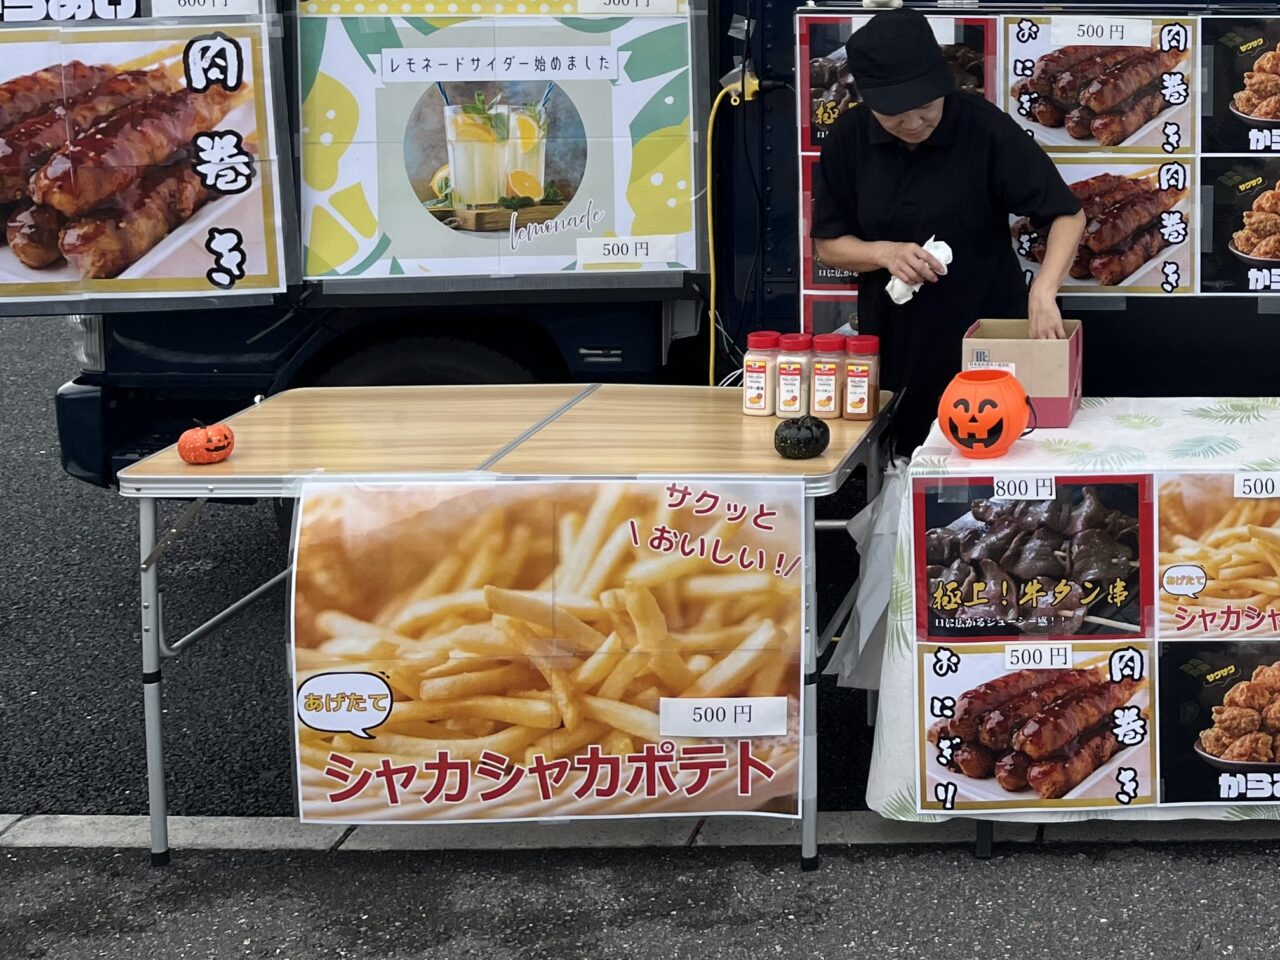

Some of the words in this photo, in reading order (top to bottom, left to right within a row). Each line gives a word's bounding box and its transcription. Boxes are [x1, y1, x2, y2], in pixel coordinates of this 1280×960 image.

[389, 54, 611, 74] レモネードサイダー始めました
[508, 200, 607, 251] lemonade
[664, 482, 777, 531] サクッと
[1165, 573, 1206, 587] あげたて
[1206, 665, 1235, 682] サクサク
[303, 691, 391, 714] あげたて
[931, 647, 960, 810] おにぎり
[324, 740, 776, 806] シャカシャカポテト
